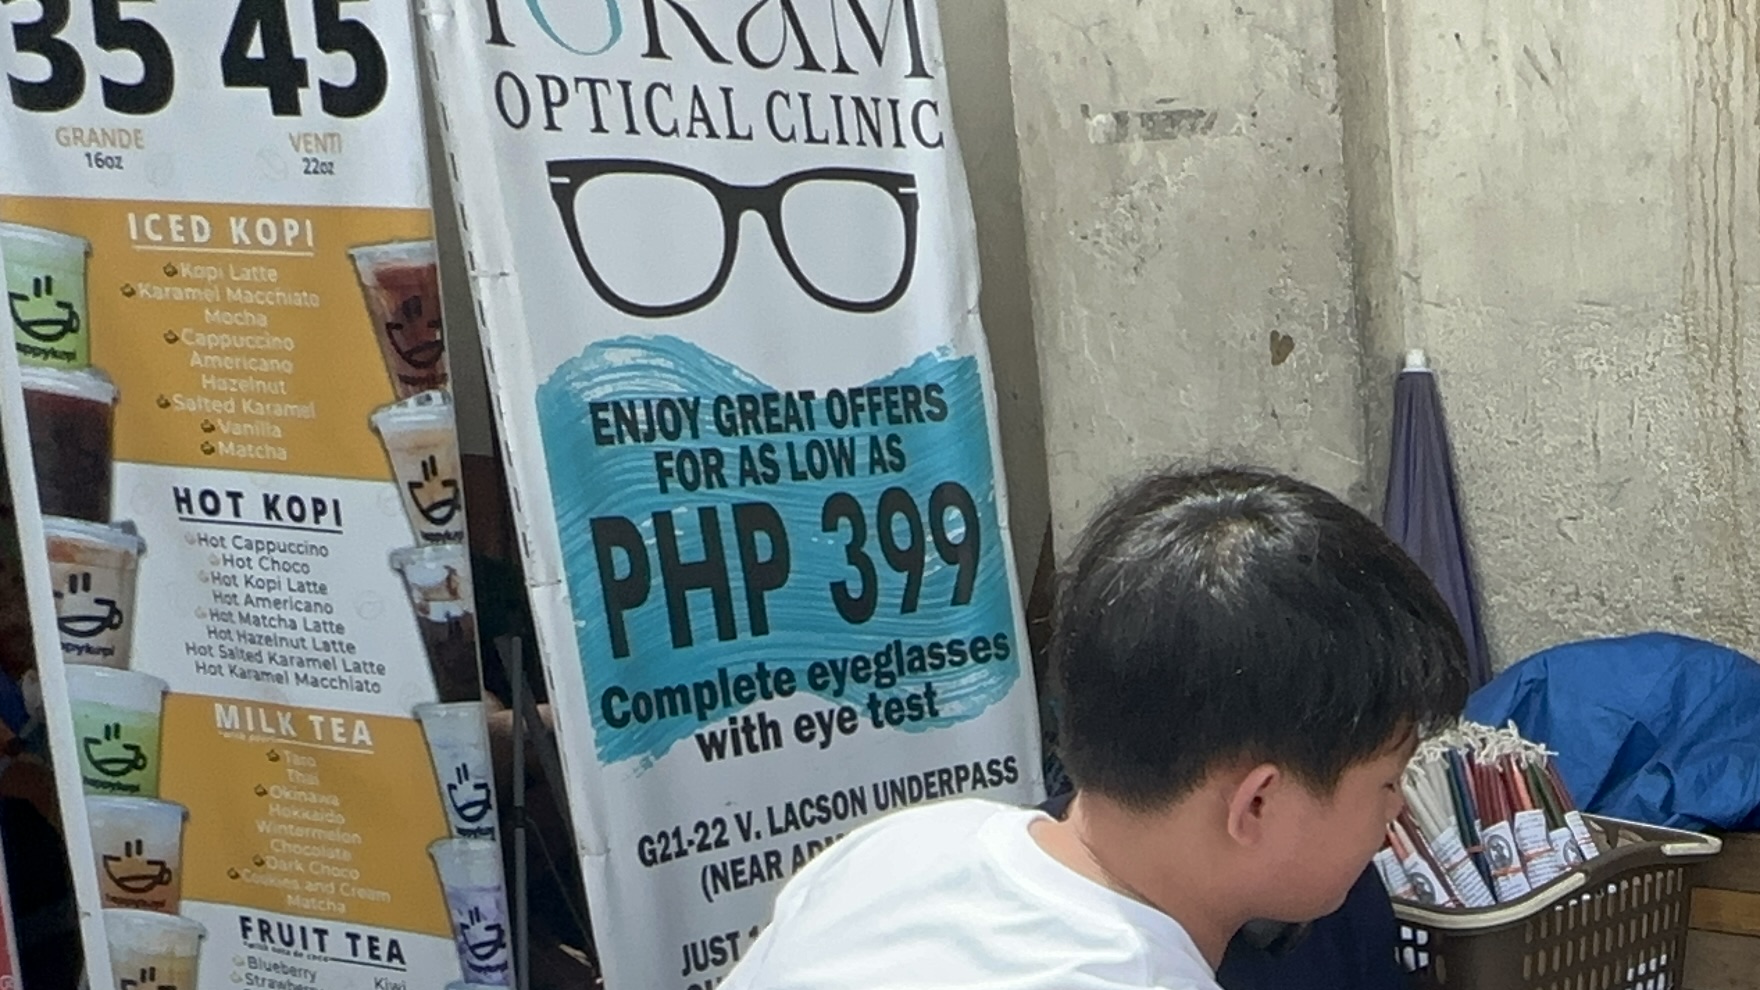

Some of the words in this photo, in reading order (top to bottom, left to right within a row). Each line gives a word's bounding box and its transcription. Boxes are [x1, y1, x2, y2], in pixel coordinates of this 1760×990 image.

[7, 0, 175, 114] 35
[220, 0, 389, 119] 45
[494, 70, 754, 141] OPTICAL
[765, 90, 945, 149] CLINIC
[56, 126, 145, 149] GRANDE
[289, 132, 343, 154] VENTI
[85, 151, 125, 170] 16oz
[302, 157, 335, 176] 22oz
[128, 212, 211, 243] ICED
[230, 216, 314, 247] KOPI
[180, 262, 224, 283] Kopi
[229, 264, 278, 283] Latte
[137, 282, 220, 303] Karamel
[204, 309, 268, 327] Mocha
[181, 328, 295, 351] Cappuccino
[190, 351, 294, 375] Americano
[202, 374, 287, 396] Hazelnut
[589, 396, 701, 446] ENJOY
[713, 390, 818, 437] GREAT
[825, 383, 949, 430] OFFERS
[218, 441, 287, 461] Matcha
[653, 447, 729, 494] FOR
[738, 442, 781, 487] AS
[788, 437, 858, 481] LOW
[868, 433, 908, 475] AS
[173, 486, 244, 518] HOT
[262, 493, 343, 527] KOPI
[197, 532, 227, 550] Hot
[231, 535, 329, 558] Cappuccino
[222, 553, 253, 571] Hot
[258, 556, 311, 575] Choco
[589, 501, 791, 659] PHP
[821, 481, 982, 625] 399
[210, 571, 239, 588] Hot
[244, 574, 282, 593] Kopi
[287, 578, 328, 596] Latte
[212, 590, 239, 606] Hot
[244, 592, 334, 615] Americano
[209, 608, 234, 624] Hot
[238, 611, 298, 631] Matcha
[303, 617, 345, 635] Latte
[206, 625, 234, 642] Hot
[237, 629, 307, 650] Hazelnut
[312, 636, 356, 655] Latte
[185, 642, 213, 659] Hot
[268, 652, 337, 673] Karamel
[342, 658, 386, 676] Latte
[195, 660, 223, 677] Hot
[228, 664, 289, 685] Karamel
[295, 672, 382, 694] Macchiato
[601, 661, 798, 730] Complete
[807, 632, 1012, 695] eyeglasses
[214, 703, 298, 737] MILK
[308, 715, 373, 746] TEA
[695, 711, 783, 763] with
[794, 703, 859, 751] eye
[867, 682, 940, 728] test
[637, 816, 730, 868] G21-22
[734, 811, 762, 843] V.
[767, 786, 868, 836] LACSON
[873, 755, 1019, 812] UNDERPASS
[701, 849, 784, 903] (NEAR
[239, 915, 329, 953] FRUIT
[345, 931, 407, 966] TEA
[681, 930, 741, 977] JUST
[247, 955, 318, 984] Blueberry
